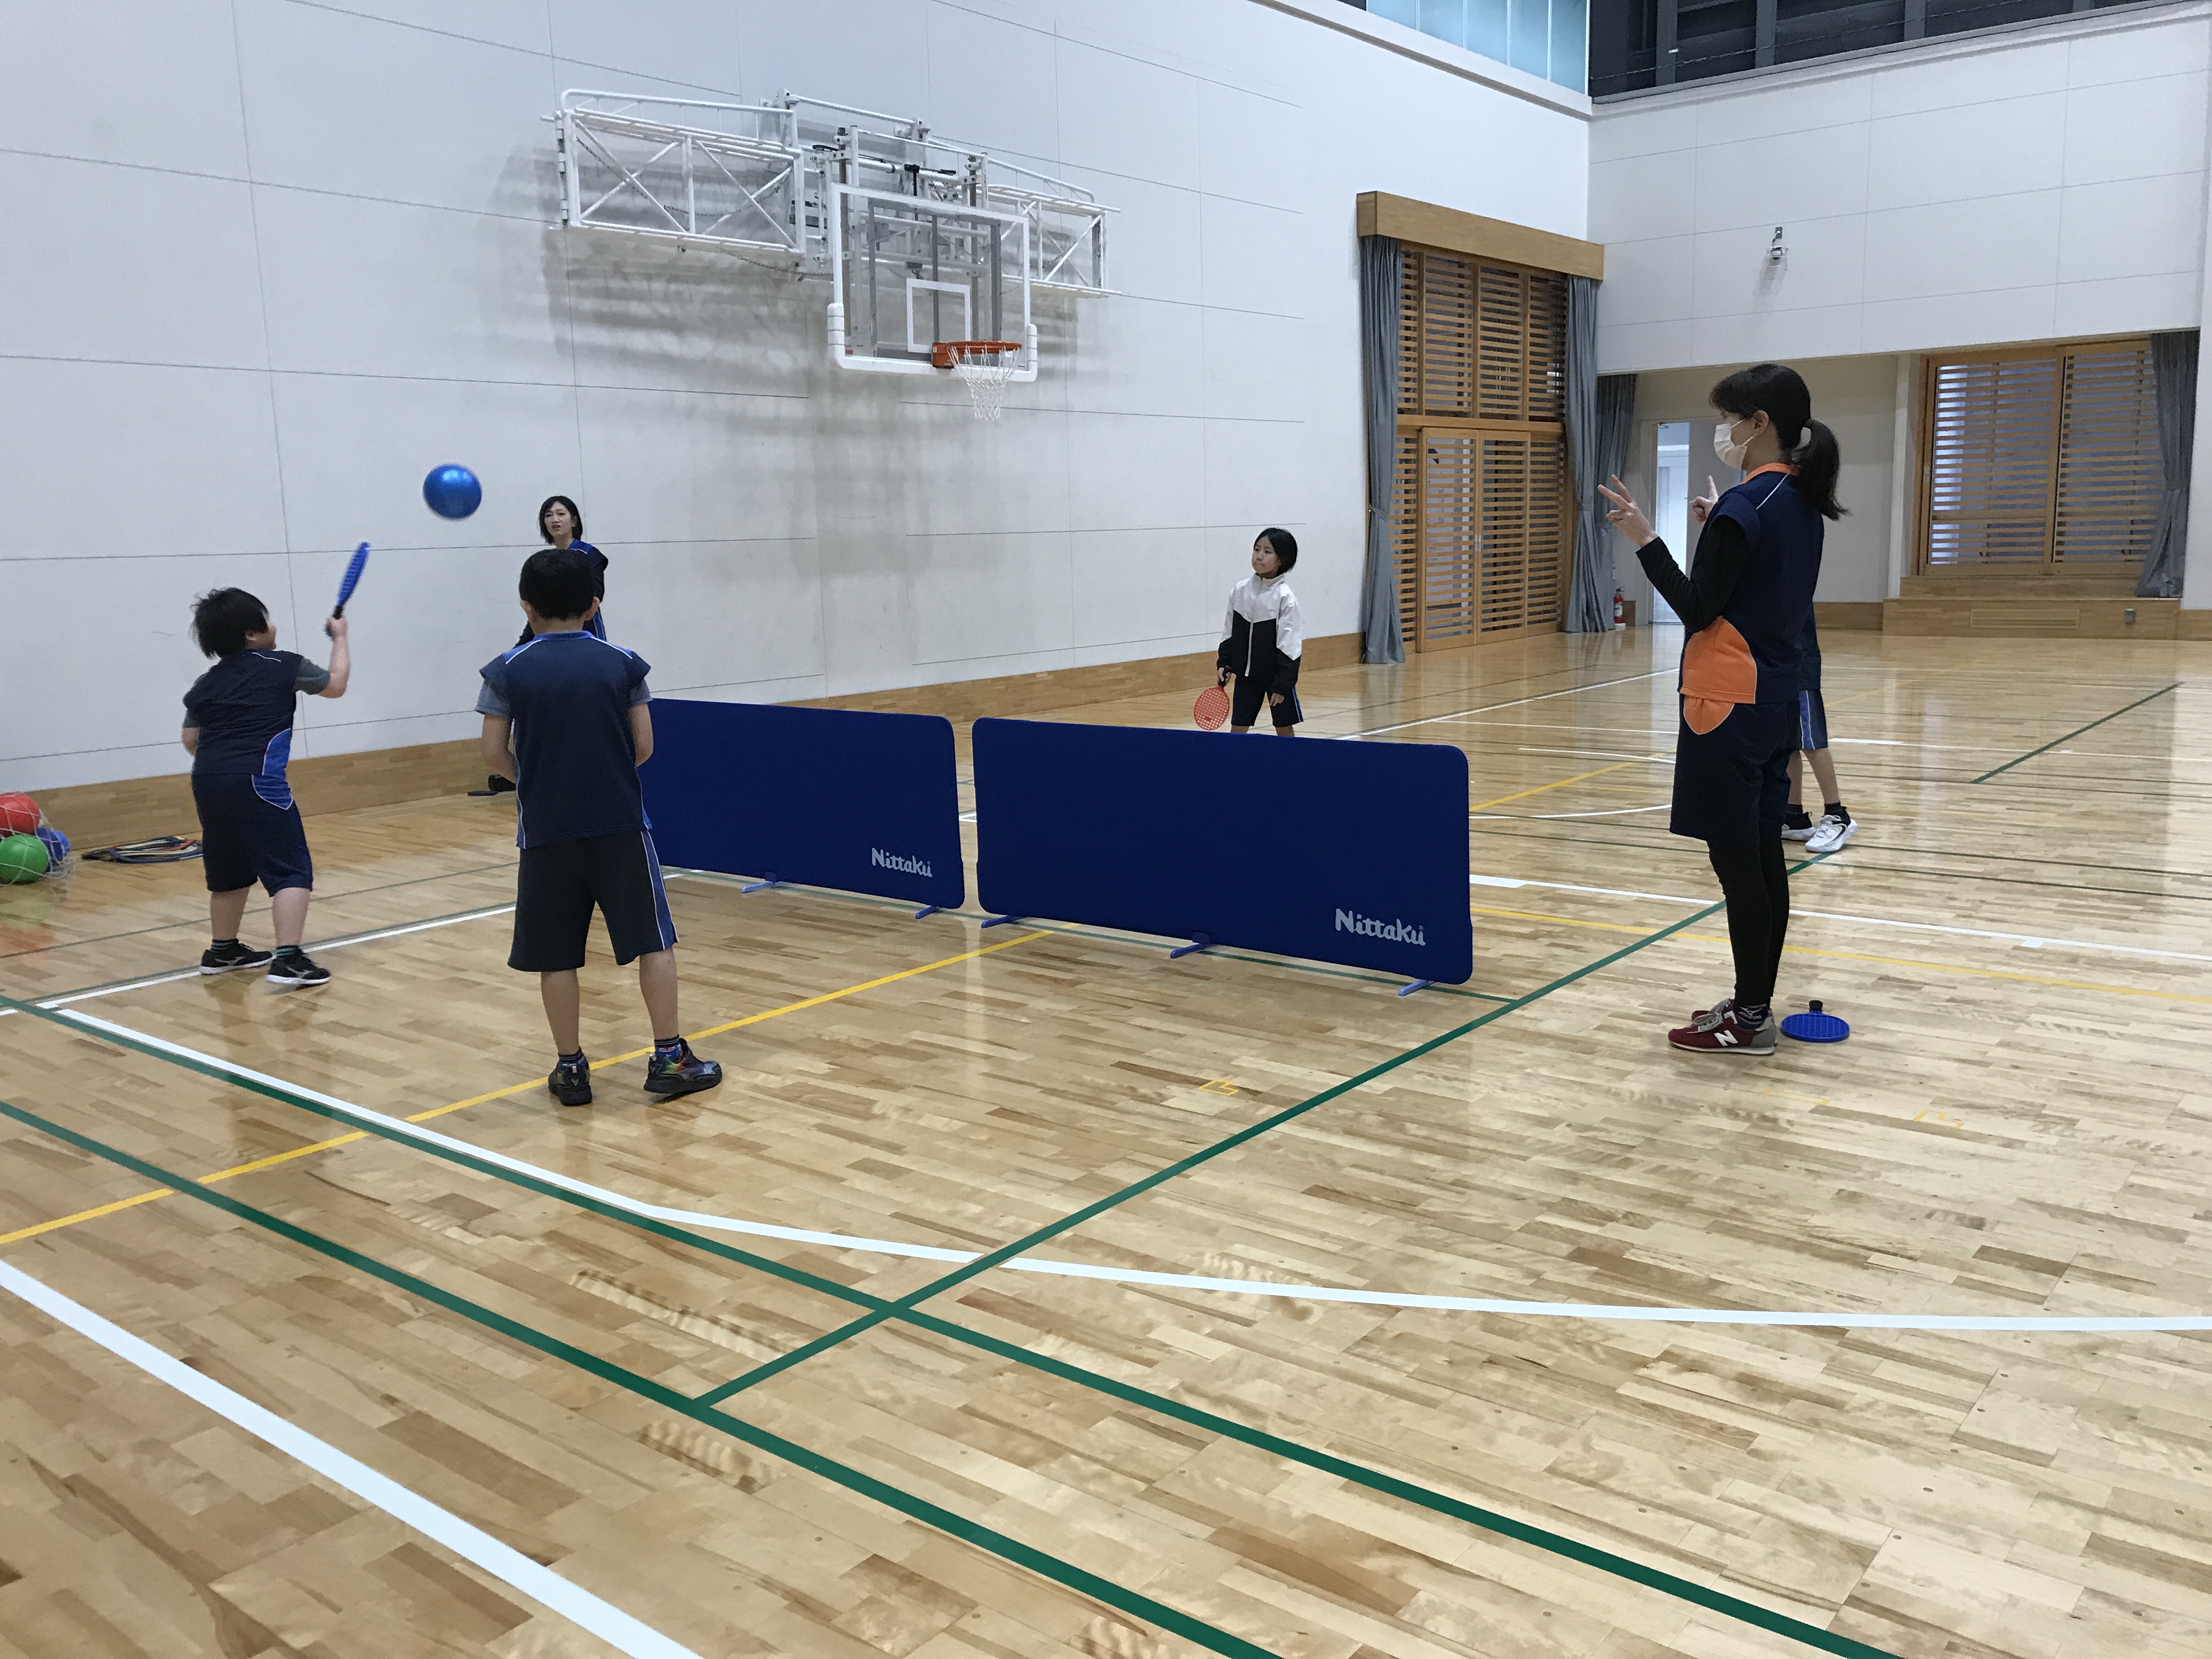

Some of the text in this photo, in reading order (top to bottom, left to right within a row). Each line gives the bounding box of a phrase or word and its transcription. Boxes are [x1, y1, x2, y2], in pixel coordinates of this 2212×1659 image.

[871, 847, 933, 878] Nittaku
[1335, 908, 1426, 946] Nittaku
[1713, 1029, 1739, 1047] N
